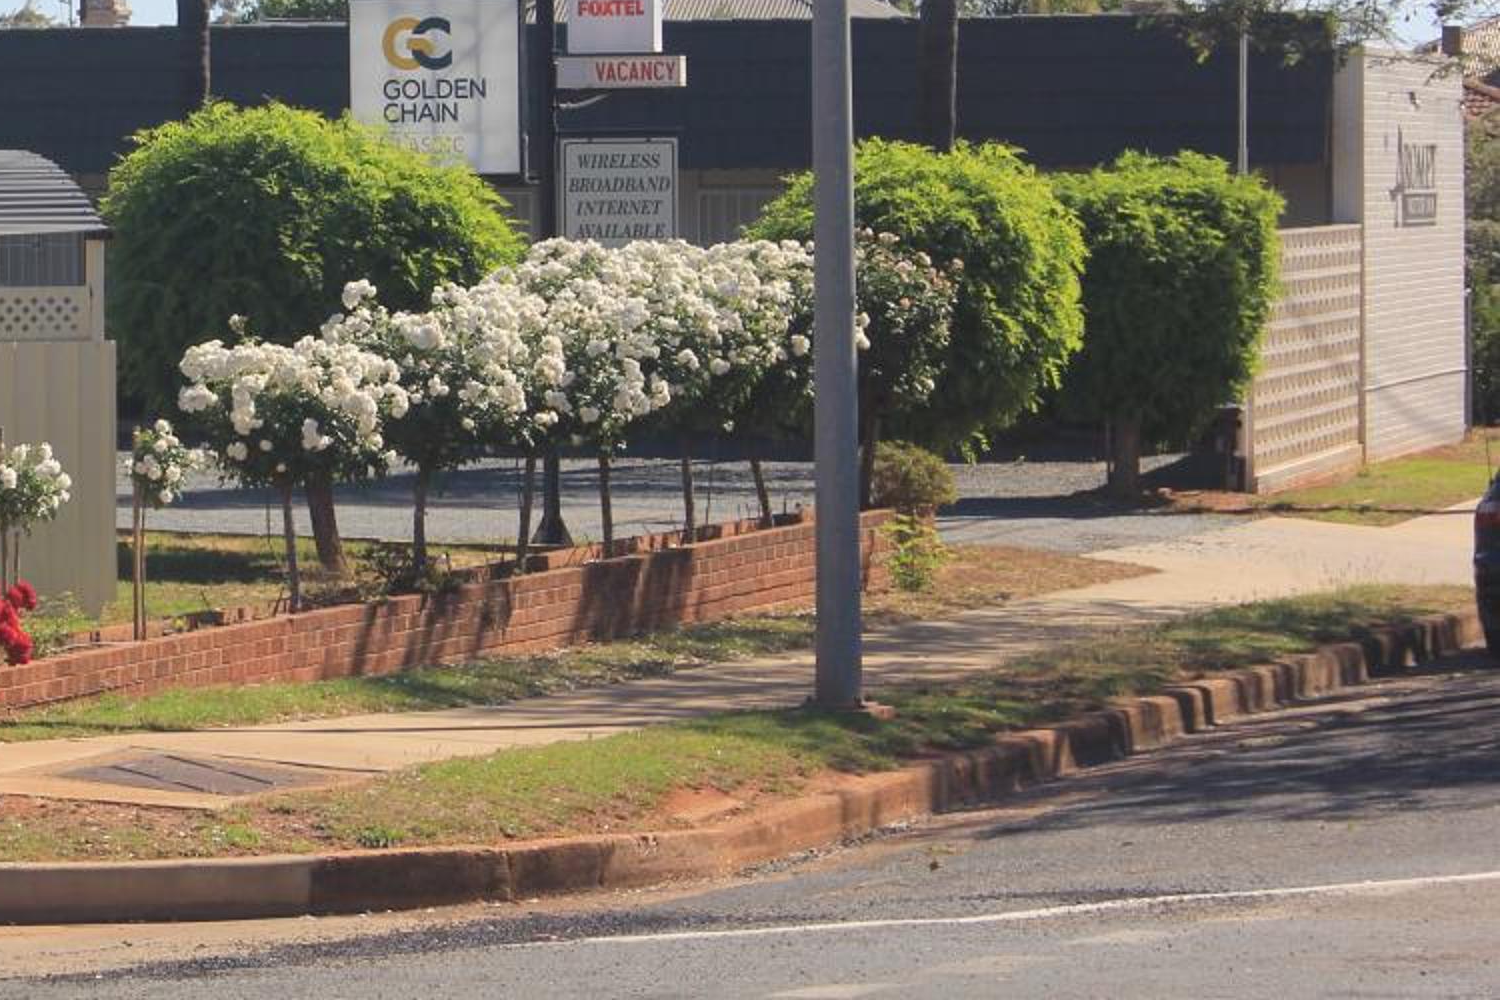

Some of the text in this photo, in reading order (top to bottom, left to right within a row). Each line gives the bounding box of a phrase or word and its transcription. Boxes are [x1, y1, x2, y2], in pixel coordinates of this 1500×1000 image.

[578, 0, 644, 17] FOXTEL
[596, 60, 676, 82] VACANCY
[383, 78, 486, 100] GOLDEN
[383, 102, 459, 123] CHAIN
[578, 152, 661, 169] WIRELESS
[569, 175, 671, 193] BROADBAND
[577, 199, 663, 216] INTERNET
[576, 222, 667, 239] AVAILABLE
